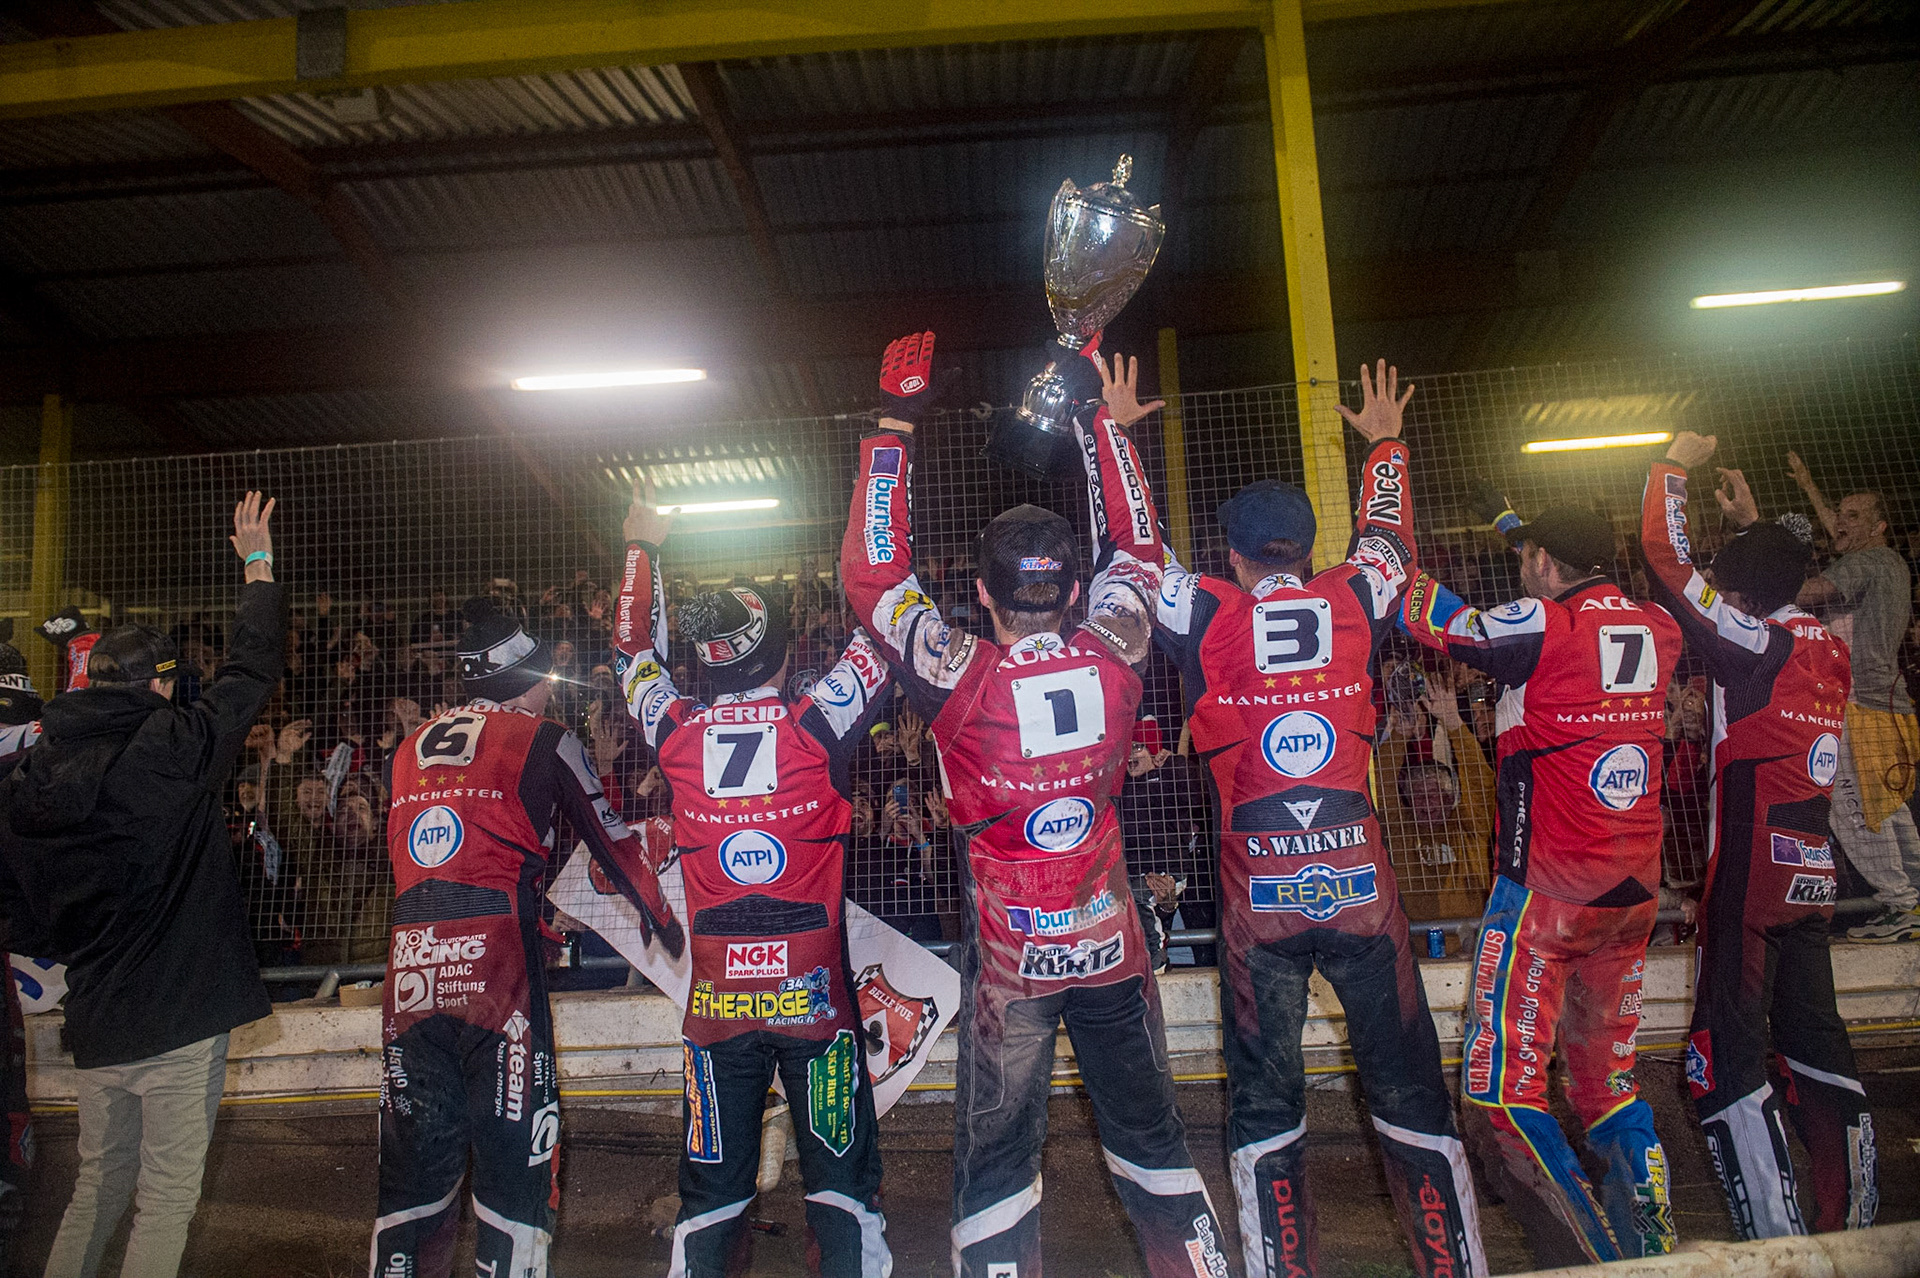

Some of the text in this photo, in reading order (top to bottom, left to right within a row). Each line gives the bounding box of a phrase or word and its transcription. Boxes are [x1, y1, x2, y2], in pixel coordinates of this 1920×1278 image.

[1367, 462, 1402, 525] Nice
[1409, 589, 1425, 622] GLENIS
[1265, 608, 1320, 665] 3
[1610, 633, 1645, 685] 7
[1218, 682, 1362, 705] MANCHESTER
[1044, 688, 1079, 736] 1
[1557, 711, 1665, 723] MANCHESTE
[420, 717, 475, 759] 6
[1275, 732, 1321, 754] ATPI
[717, 732, 763, 789] 7
[1815, 751, 1837, 769] ATPI
[1600, 768, 1641, 792] ATPI
[392, 788, 504, 809] MANCHESTER
[684, 800, 819, 824] MANCHESTER
[1038, 814, 1084, 835] ATPI
[417, 825, 451, 846] ATPI
[1247, 825, 1367, 856] S. WARNER
[731, 849, 773, 867] ATPI
[1276, 879, 1361, 904] REALL
[1034, 889, 1117, 930] burnside
[440, 933, 487, 945] CLUTCHPLATES
[393, 940, 487, 969] RACING
[728, 943, 785, 967] NGK
[439, 963, 473, 978] ADAC
[728, 967, 785, 977] SPARK PLUGS
[436, 979, 487, 995] Stiftung
[435, 995, 469, 1009] Sport
[692, 989, 811, 1018] ETHERIDGE
[868, 986, 914, 1022] BELLE VUE
[767, 1015, 804, 1026] RACING
[496, 1041, 507, 1064] bau
[827, 1049, 837, 1077] SKIP
[534, 1051, 545, 1087] Sport
[506, 1043, 528, 1122] team
[826, 1079, 837, 1107] HIRE
[1272, 1179, 1307, 1278] ytona
[1419, 1187, 1455, 1278] dayto
